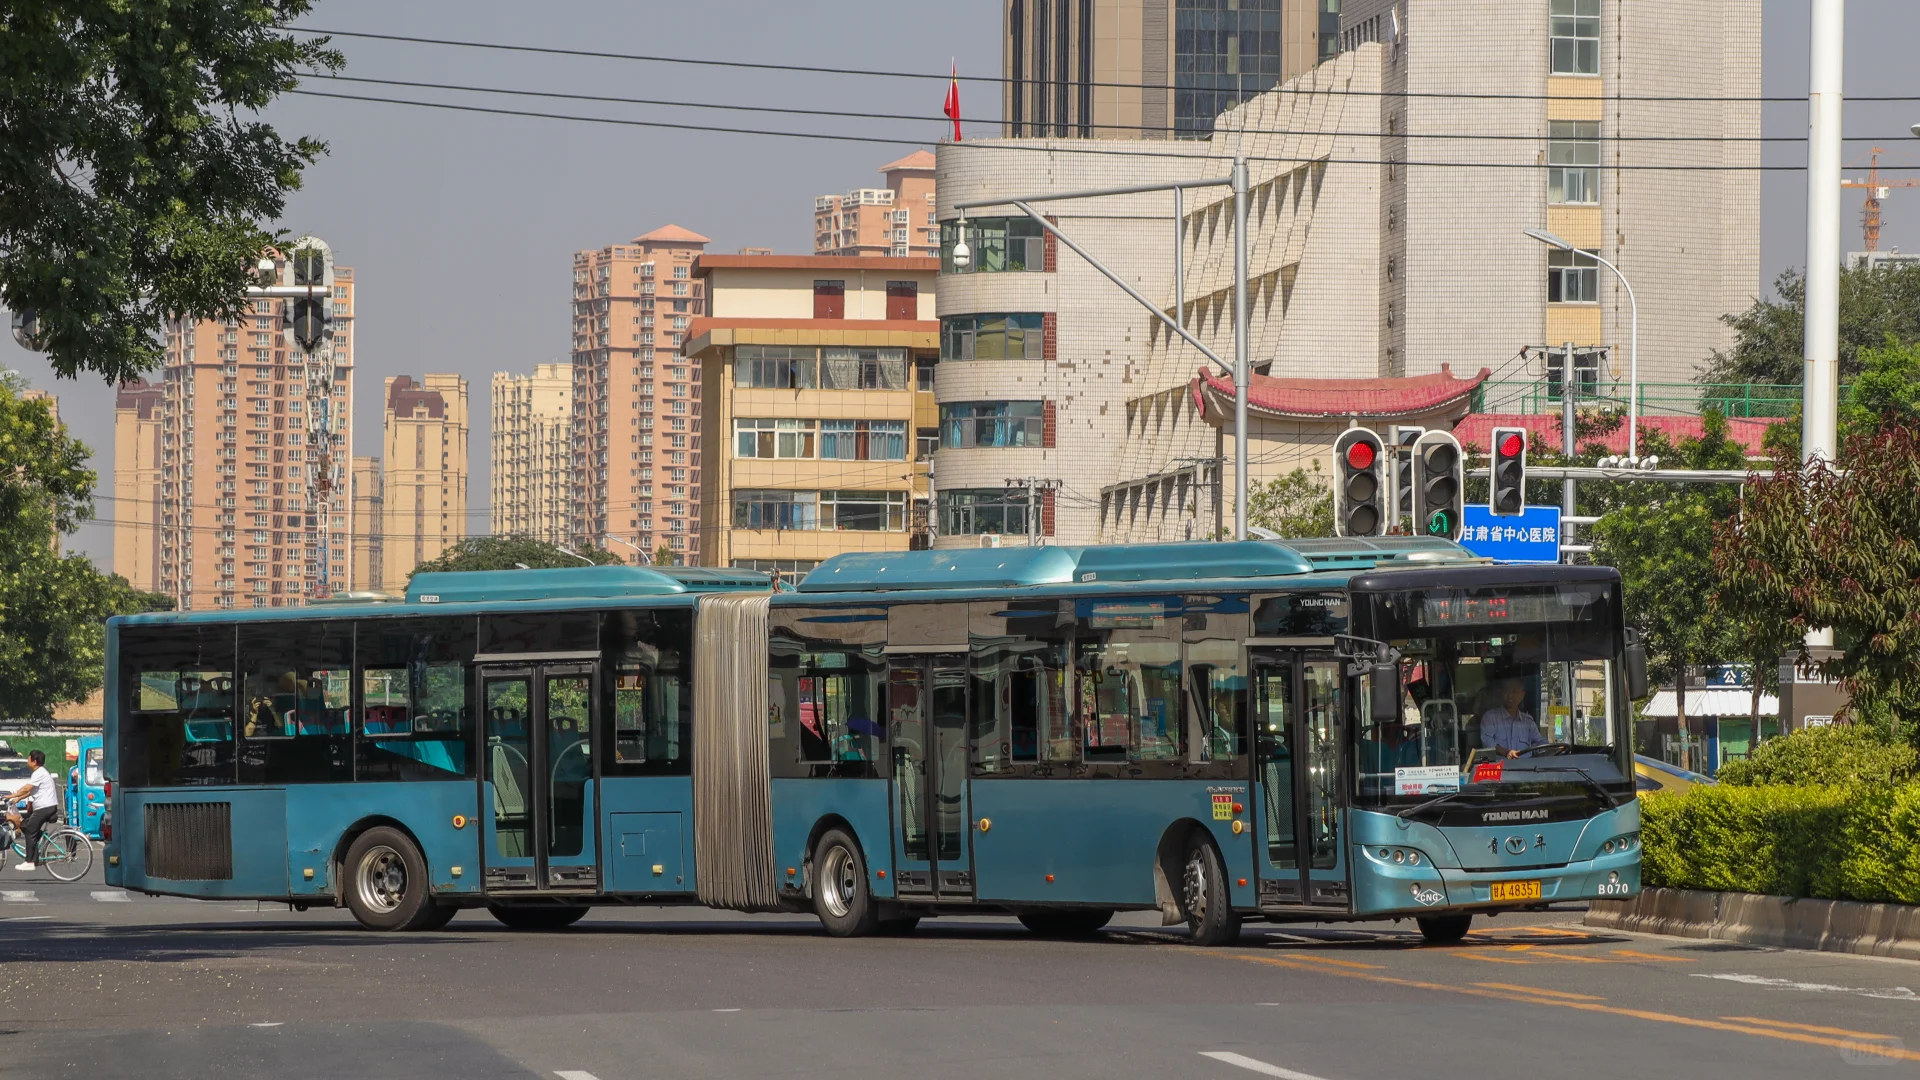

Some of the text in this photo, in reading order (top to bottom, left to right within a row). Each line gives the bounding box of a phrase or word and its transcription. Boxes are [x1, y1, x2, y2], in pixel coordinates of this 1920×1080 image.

[1463, 525, 1556, 543] 甘肃省中心医院
[1300, 598, 1324, 607] YOUNG
[1482, 809, 1549, 822] YOUNG MAN
[1598, 883, 1629, 895] B070
[1420, 893, 1439, 902] CNG
